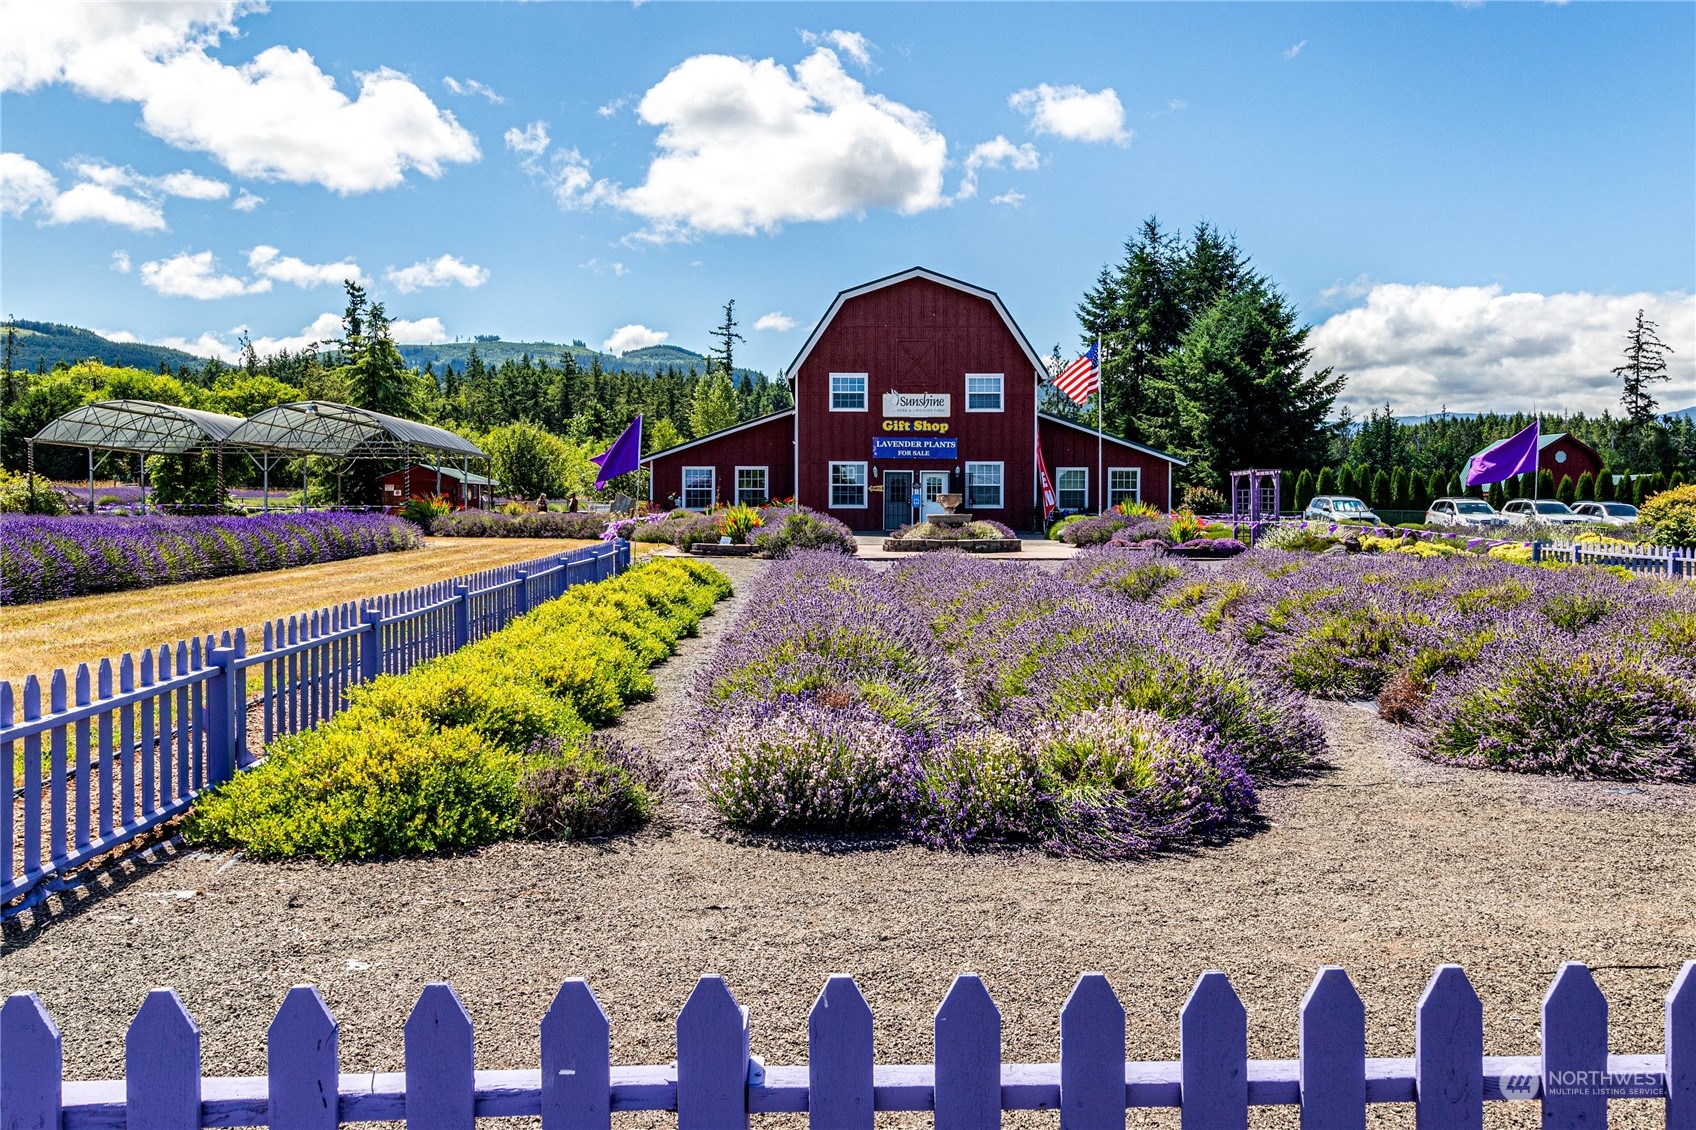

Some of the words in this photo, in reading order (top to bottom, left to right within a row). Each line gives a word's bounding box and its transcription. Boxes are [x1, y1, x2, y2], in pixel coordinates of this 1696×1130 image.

[900, 392, 945, 408] Sunshine
[882, 420, 911, 431] Gift
[913, 420, 949, 433] Shop
[876, 440, 922, 448] LAVENDER
